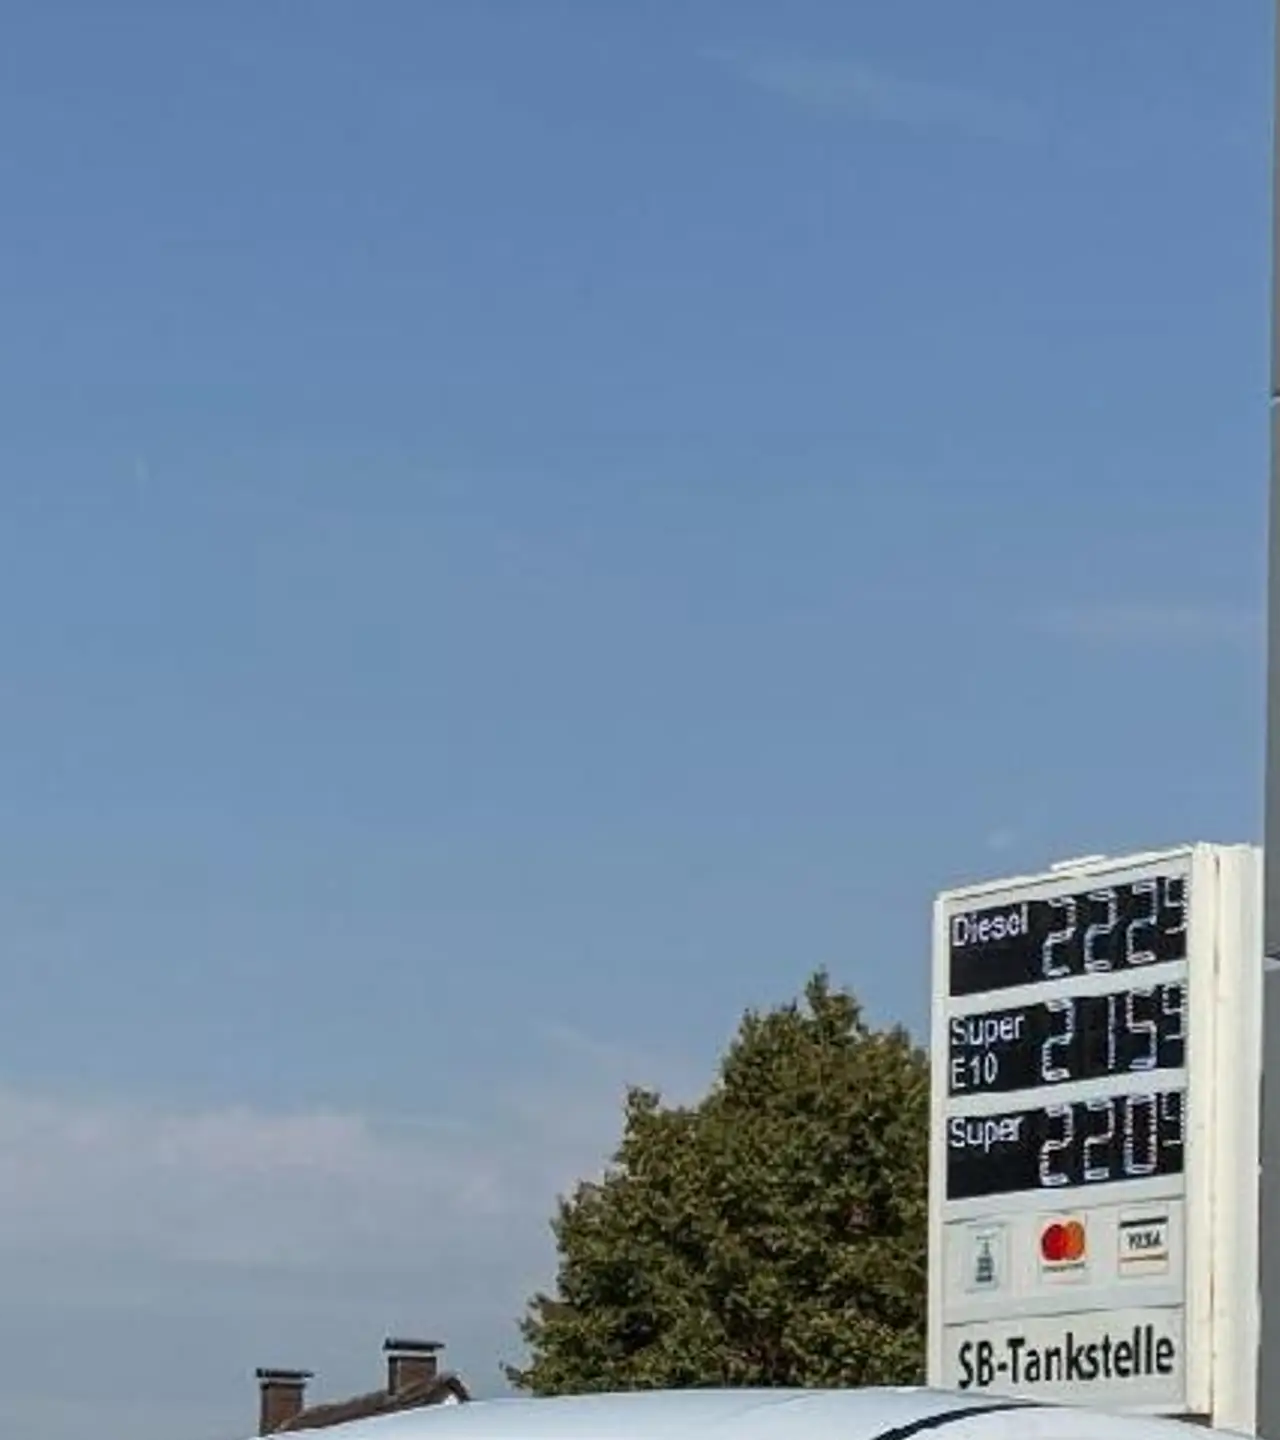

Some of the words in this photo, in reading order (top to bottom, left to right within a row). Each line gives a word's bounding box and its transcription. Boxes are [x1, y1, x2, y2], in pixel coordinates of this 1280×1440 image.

[952, 902, 1029, 947] Diesel
[951, 1015, 1025, 1047] Super
[951, 1052, 999, 1090] E10
[950, 1115, 1024, 1153] Super
[958, 1323, 1176, 1390] SB-Tankstelle
